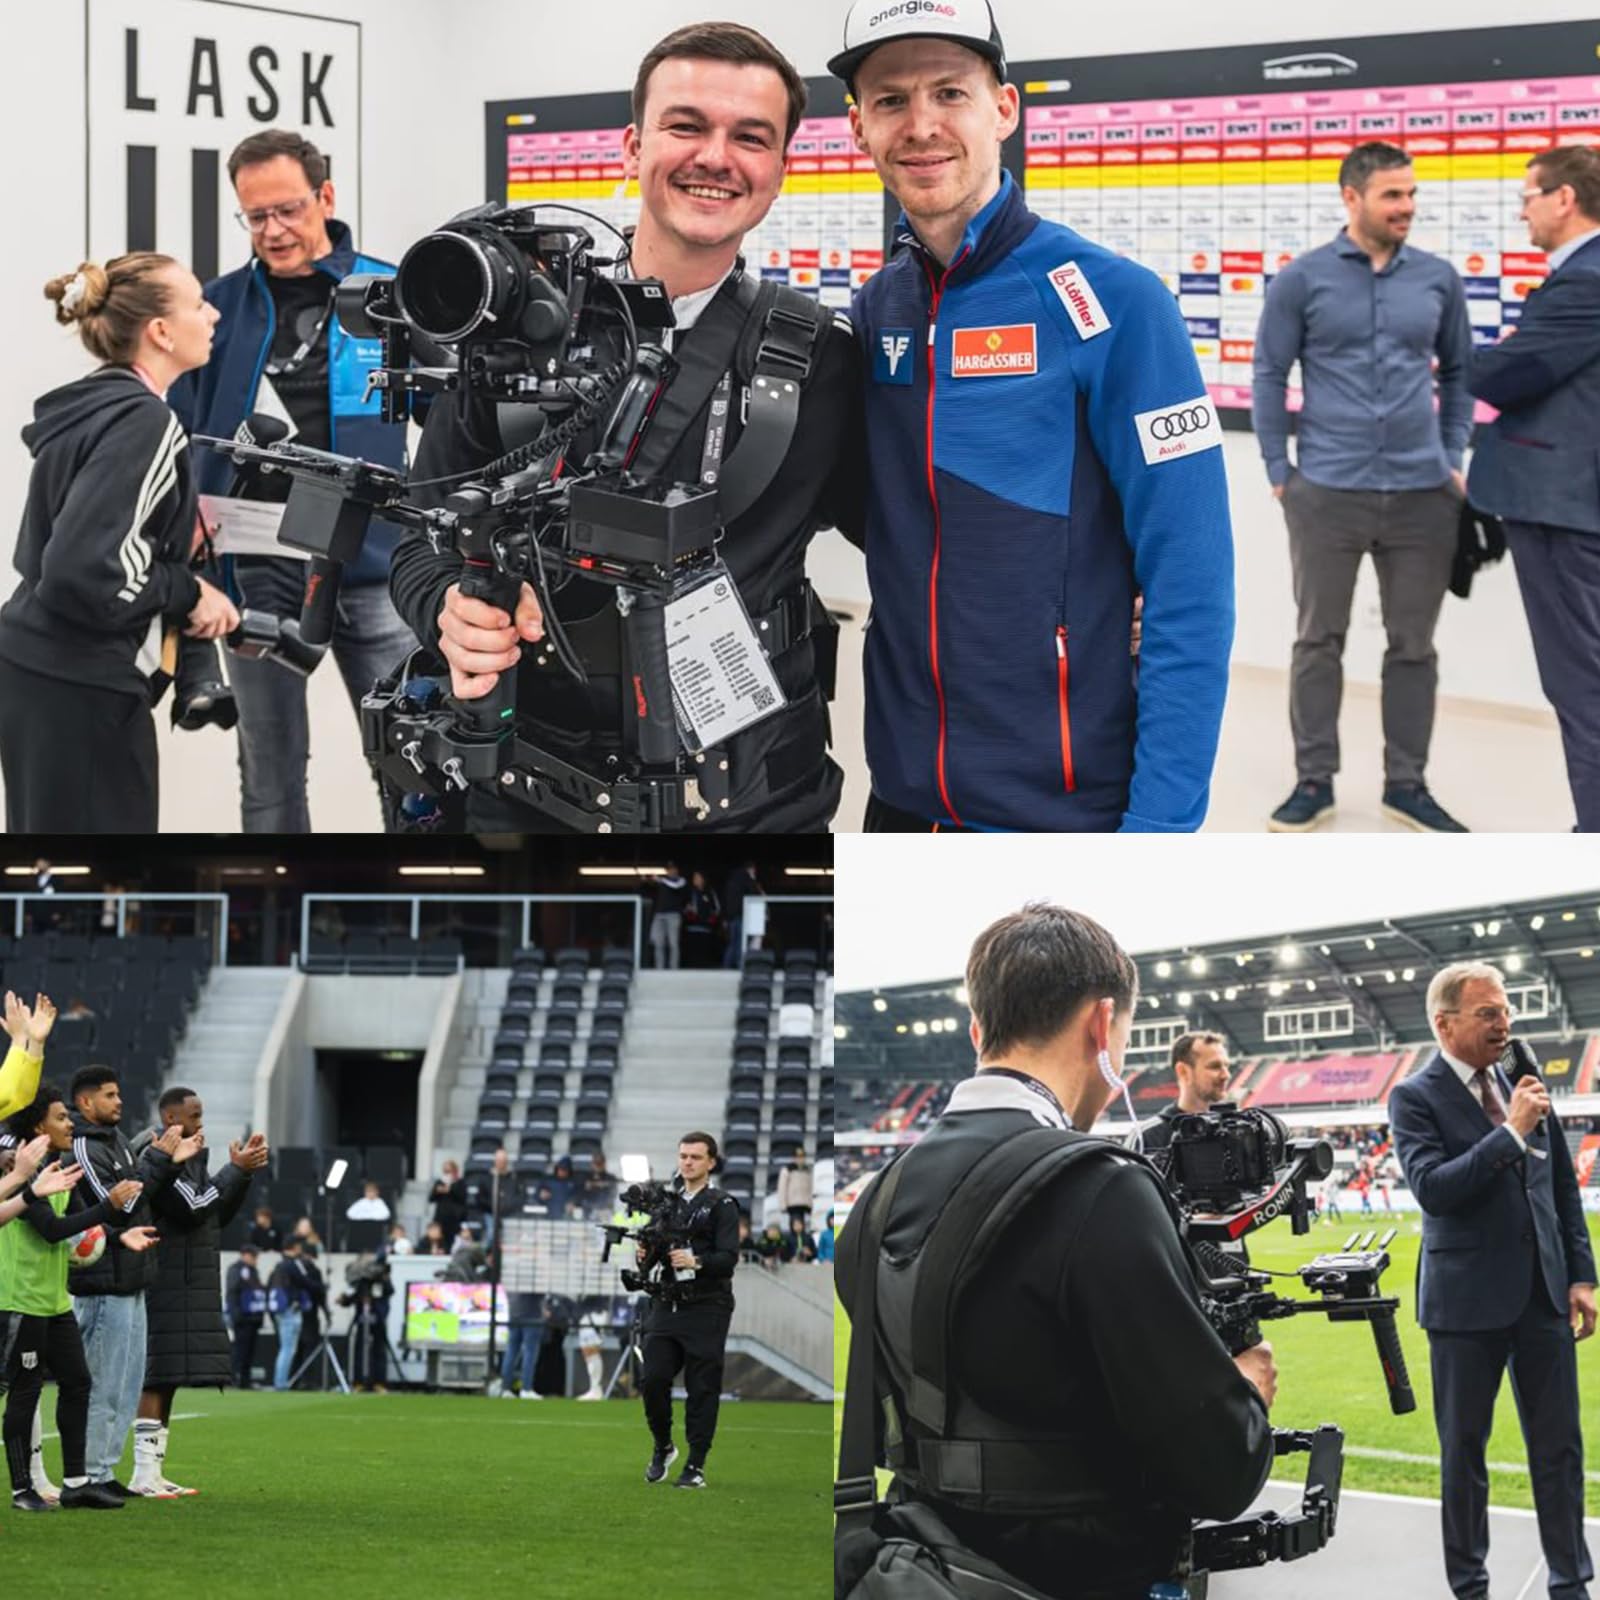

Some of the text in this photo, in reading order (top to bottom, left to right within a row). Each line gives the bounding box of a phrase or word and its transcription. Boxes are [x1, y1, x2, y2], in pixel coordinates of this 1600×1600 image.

[125, 28, 335, 127] LASK
[1064, 281, 1096, 328] Löffler
[955, 352, 1033, 369] HARGASSNER
[1159, 442, 1187, 455] Audi
[1252, 1181, 1295, 1226] RONIN
